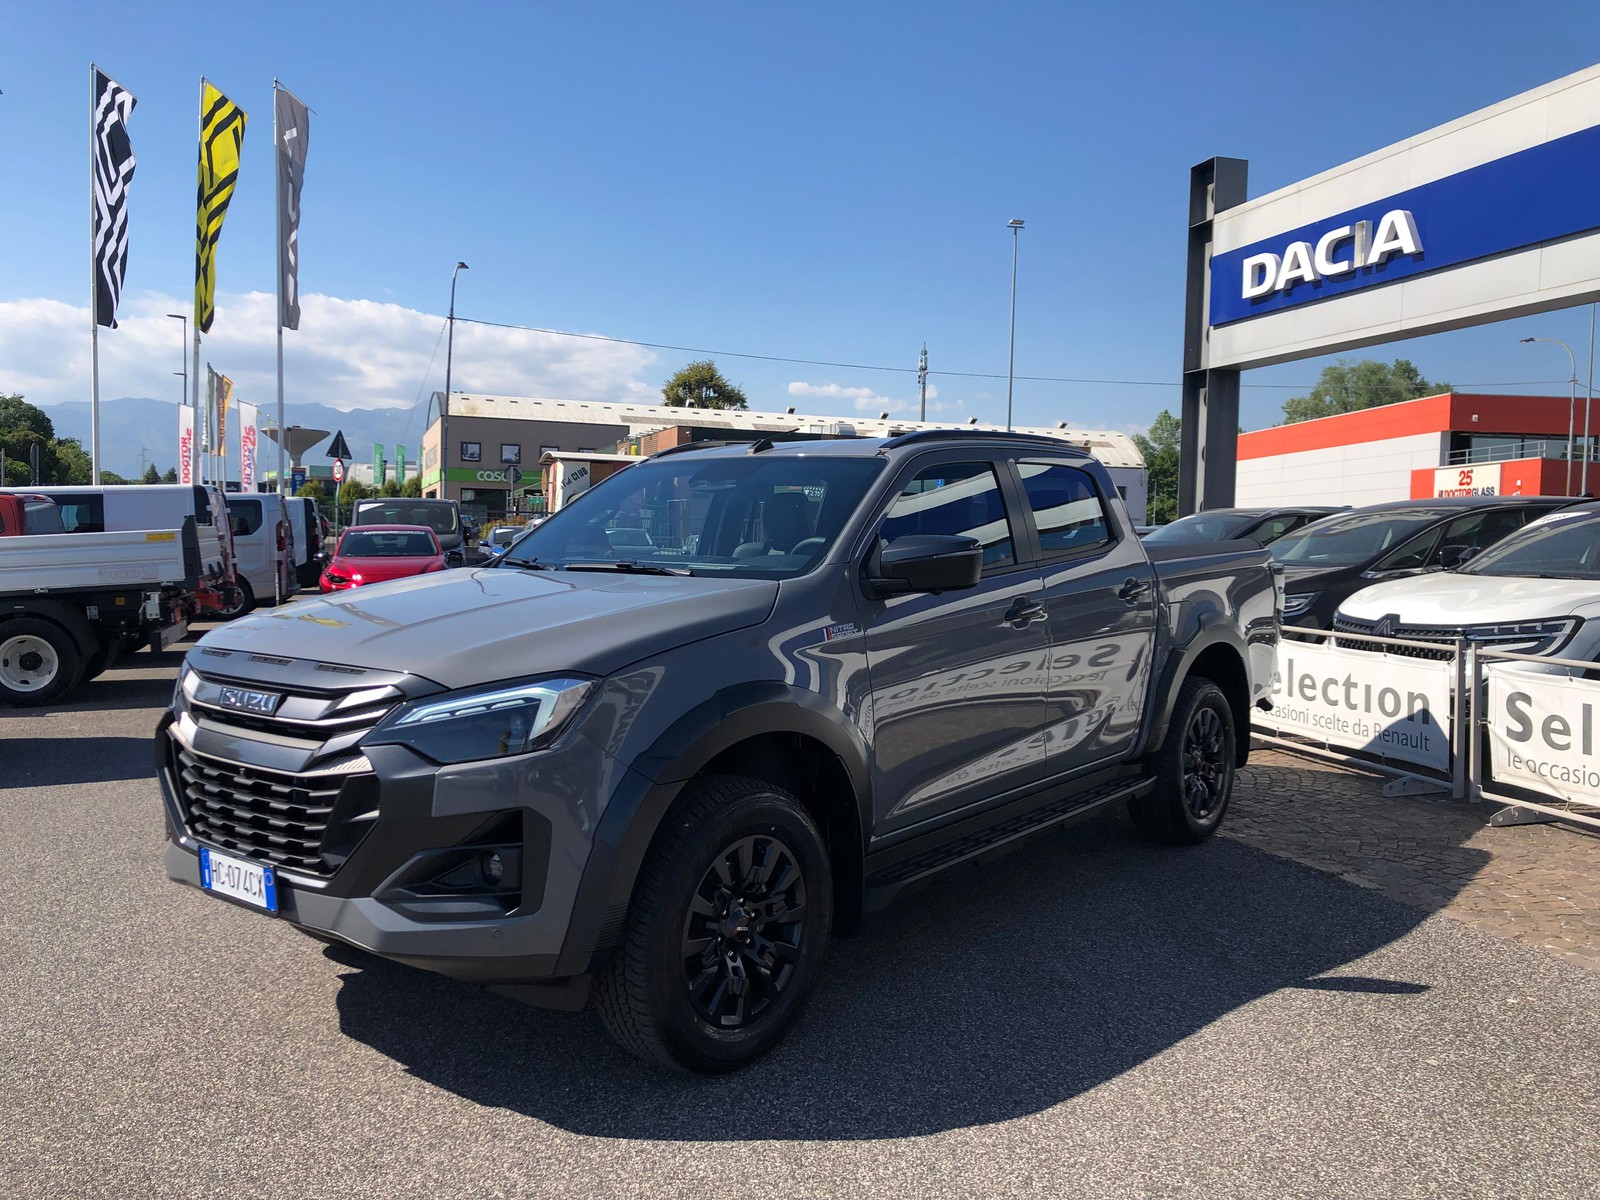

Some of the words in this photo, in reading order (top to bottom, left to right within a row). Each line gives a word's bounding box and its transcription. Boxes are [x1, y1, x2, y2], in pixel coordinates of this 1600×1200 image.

[1242, 209, 1423, 299] DACIA
[571, 467, 588, 481] CLUB
[1445, 486, 1495, 498] DOCTORGLASS
[829, 623, 854, 634] NITRO
[222, 689, 275, 712] ISUZU
[1271, 658, 1429, 725] election
[1313, 713, 1348, 734] scelte
[1353, 717, 1369, 737] da
[1374, 722, 1429, 752] Renault
[1508, 749, 1522, 770] le
